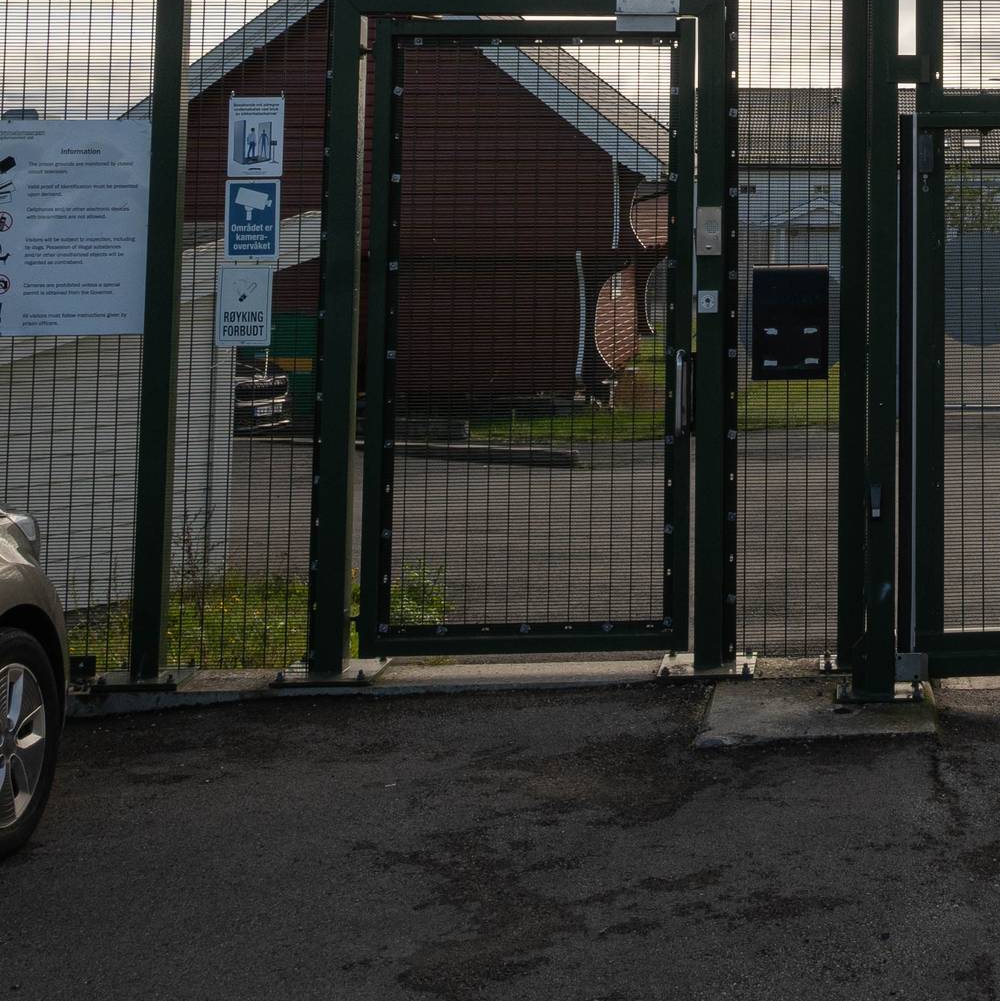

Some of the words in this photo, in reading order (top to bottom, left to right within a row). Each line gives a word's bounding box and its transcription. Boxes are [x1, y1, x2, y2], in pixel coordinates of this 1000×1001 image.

[231, 223, 263, 232] Området
[233, 241, 270, 250] overvåket
[224, 311, 264, 322] RØYKING
[222, 325, 264, 336] FORBUDT
